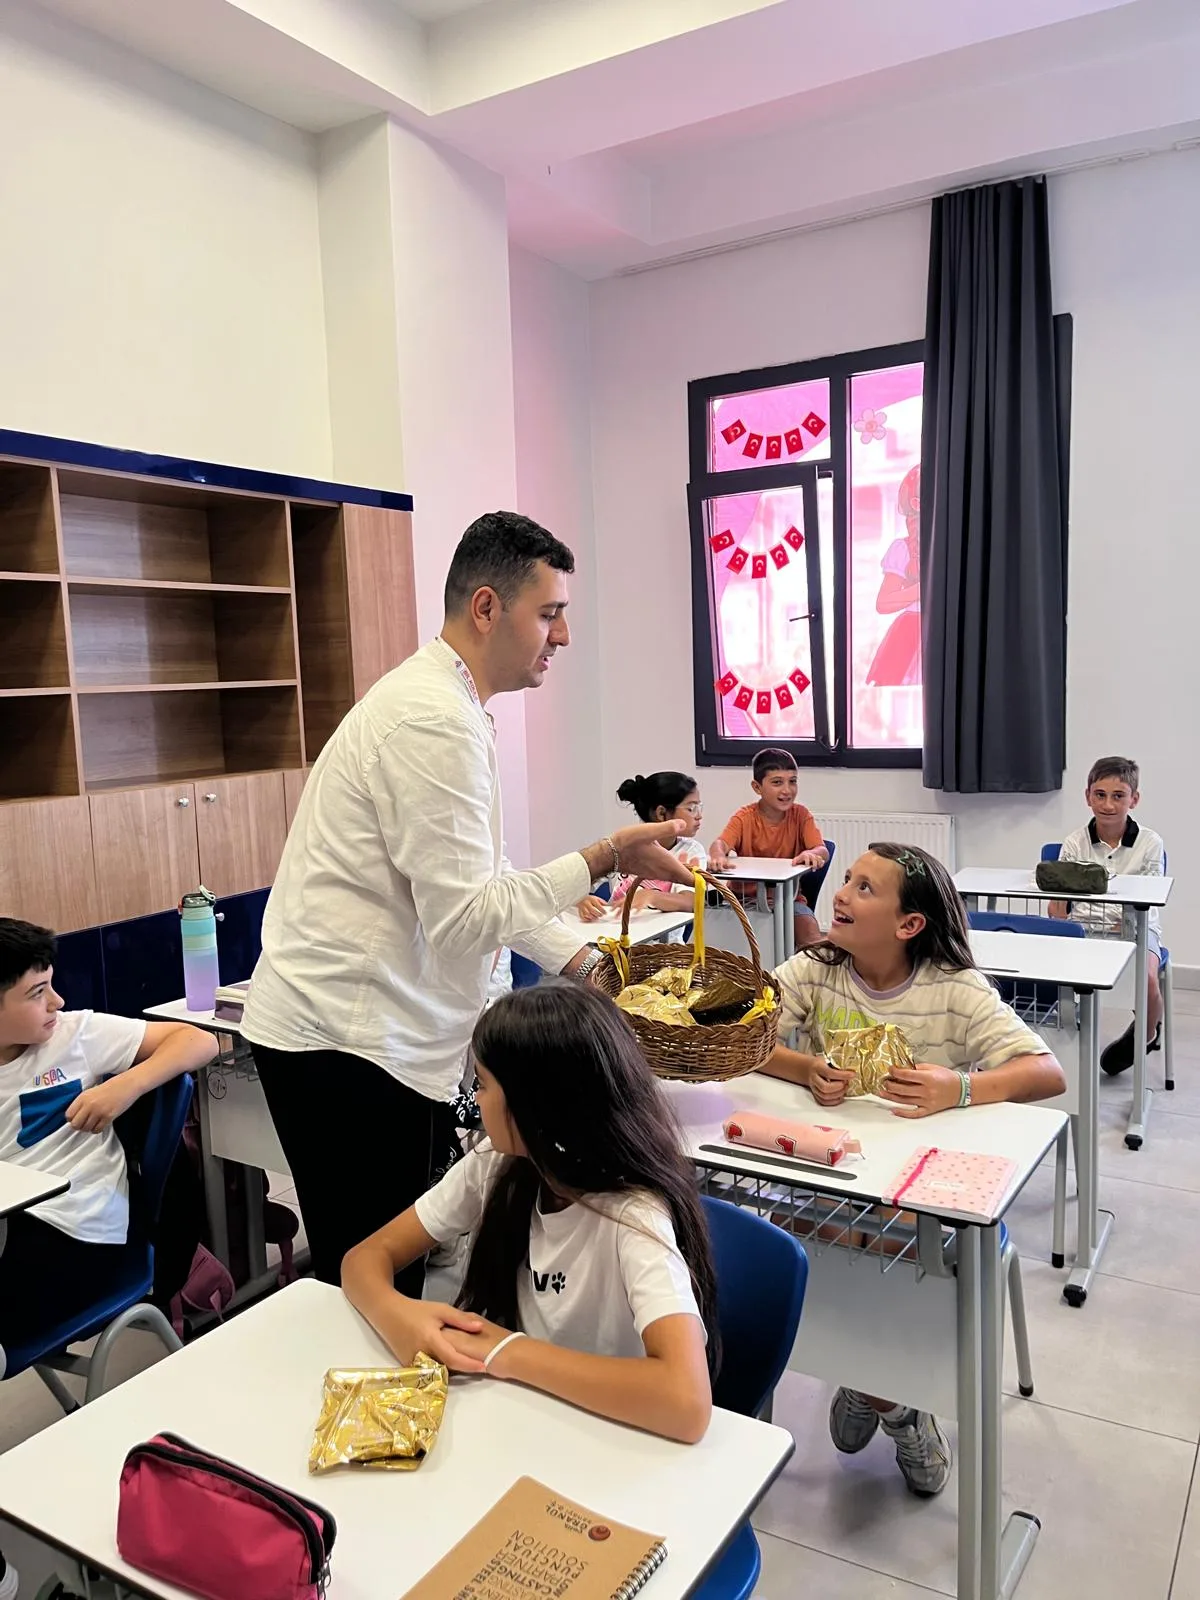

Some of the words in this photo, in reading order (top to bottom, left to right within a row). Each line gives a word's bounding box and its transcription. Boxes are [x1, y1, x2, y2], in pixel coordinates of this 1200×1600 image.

[495, 1549, 563, 1586] PARTNER
[505, 1539, 581, 1579] PUNCTUAL
[511, 1529, 589, 1571] SOLUTION
[471, 1558, 502, 1584] STEEL
[497, 1565, 553, 1595] CASTING
